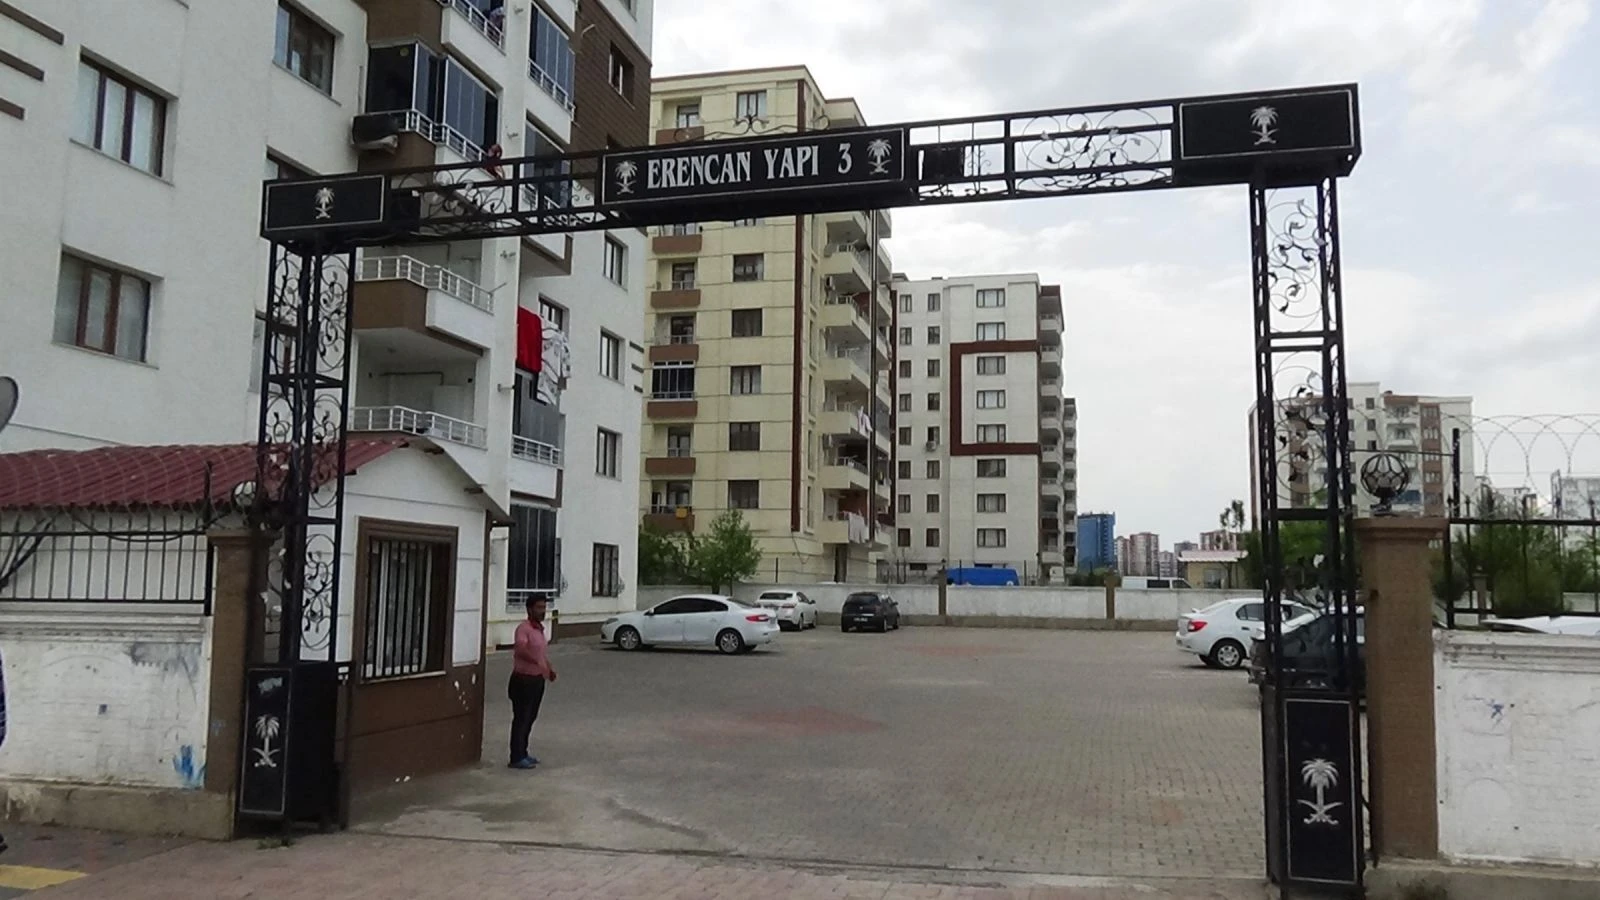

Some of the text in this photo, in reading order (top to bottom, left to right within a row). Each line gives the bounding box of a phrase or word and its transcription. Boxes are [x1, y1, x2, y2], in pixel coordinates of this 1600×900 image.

[647, 142, 853, 189] ERENCAN YAPI 3
